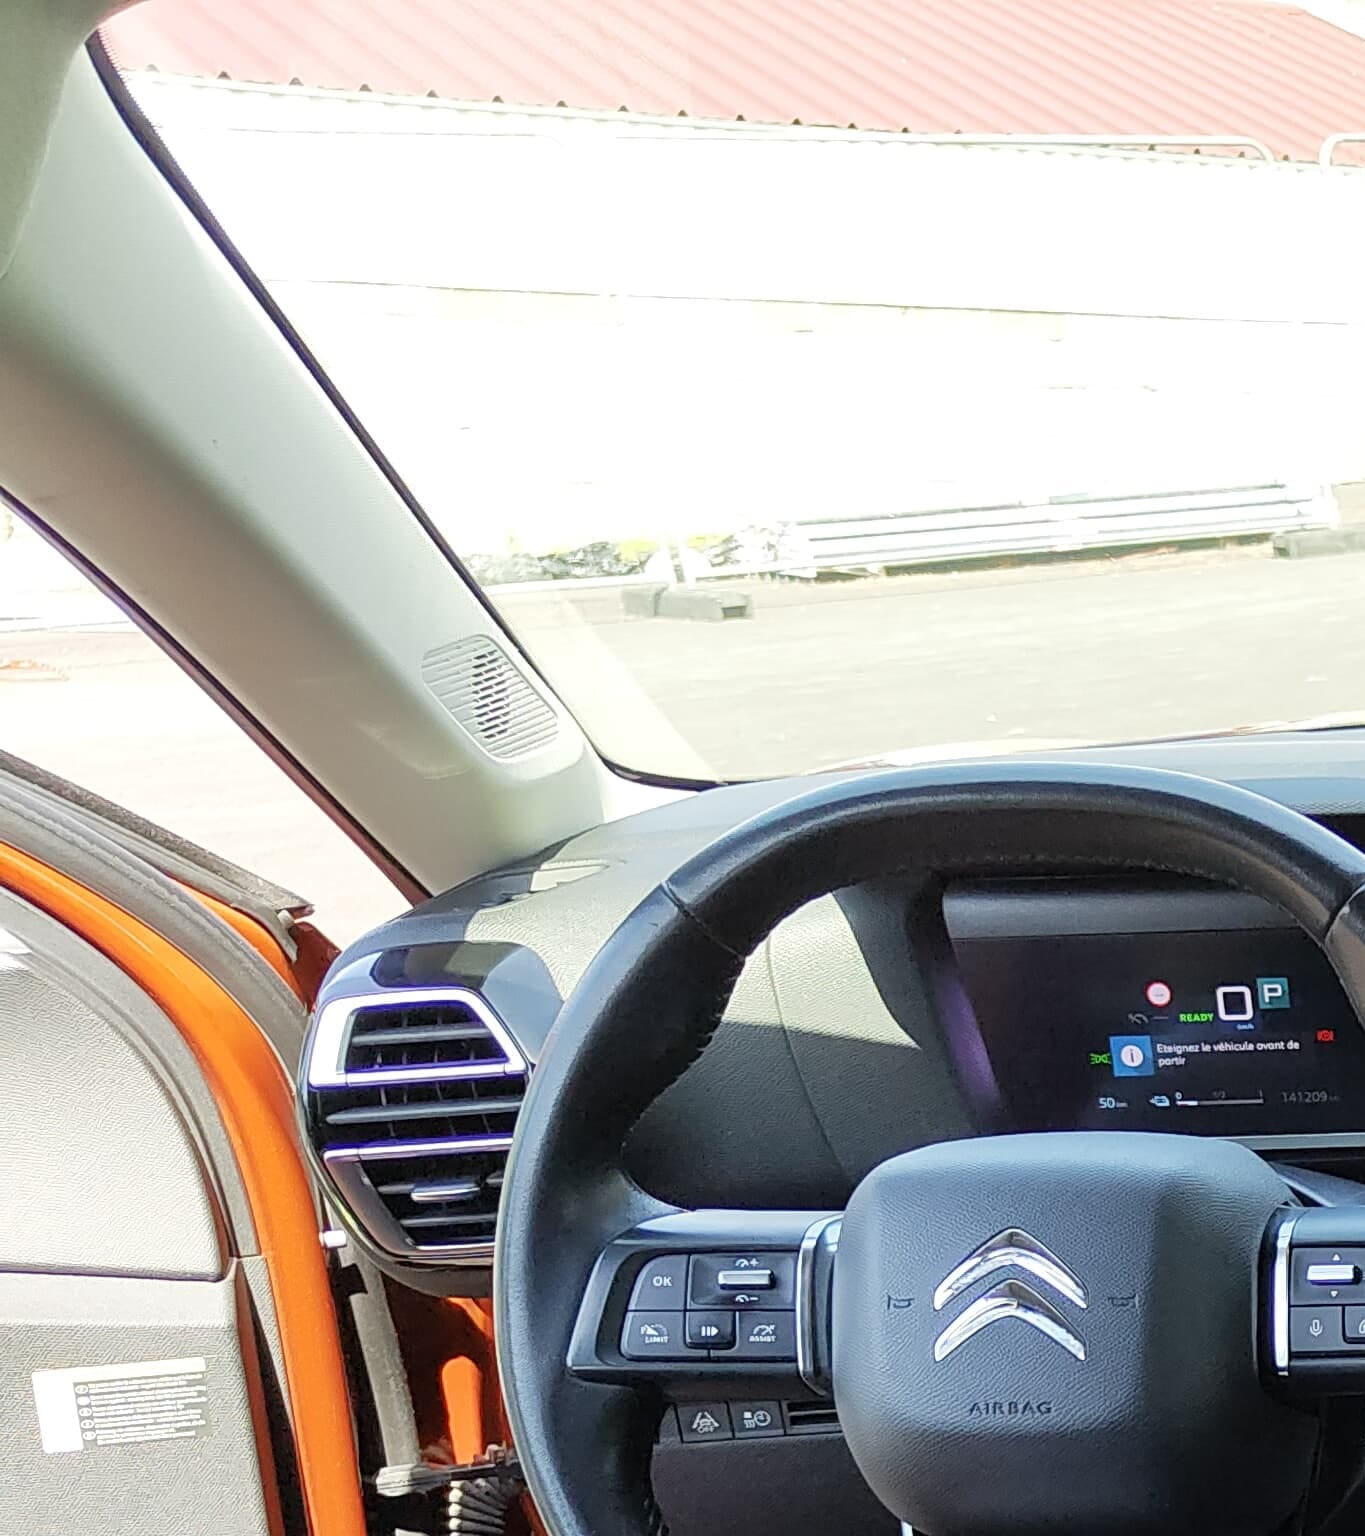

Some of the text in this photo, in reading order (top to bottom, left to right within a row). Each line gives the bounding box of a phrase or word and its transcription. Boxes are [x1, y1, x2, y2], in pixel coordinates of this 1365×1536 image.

[1262, 983, 1283, 1004] P
[1179, 1012, 1215, 1023] READY
[1201, 1041, 1211, 1052] le
[1213, 1038, 1255, 1052] véhicule
[1256, 1040, 1285, 1051] avant
[1287, 1038, 1300, 1050] de
[1157, 1056, 1187, 1068] partir
[1098, 1096, 1116, 1109] 50
[1281, 1090, 1328, 1104] 141209
[653, 1276, 672, 1287] OK
[645, 1334, 670, 1344] LIMIT
[969, 1401, 1053, 1416] AIRBAG
